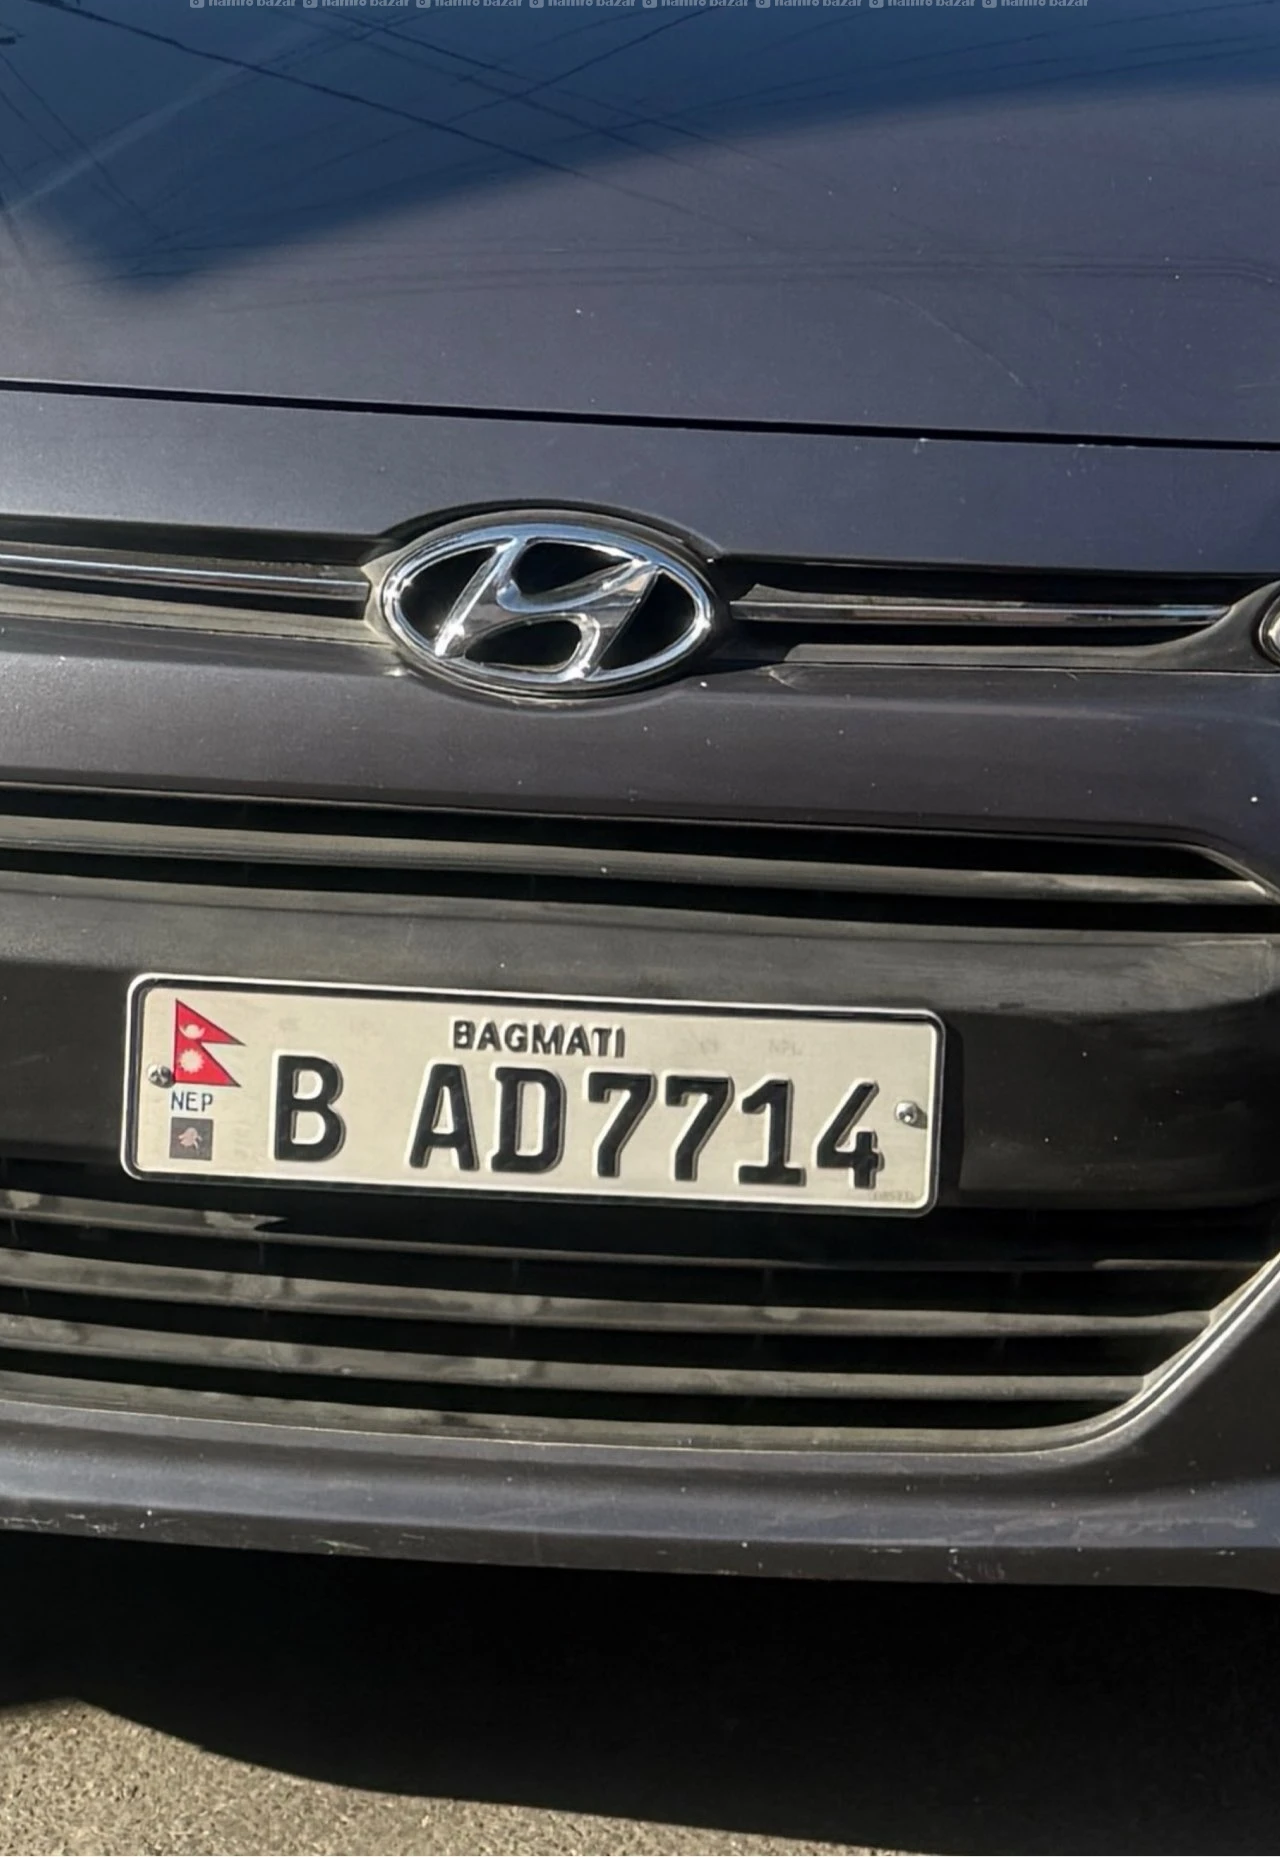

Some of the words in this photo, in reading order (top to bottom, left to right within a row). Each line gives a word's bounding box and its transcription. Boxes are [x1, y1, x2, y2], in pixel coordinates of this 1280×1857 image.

[453, 1019, 626, 1058] BAGMATI
[170, 1090, 214, 1112] NEP
[272, 1053, 347, 1163] B
